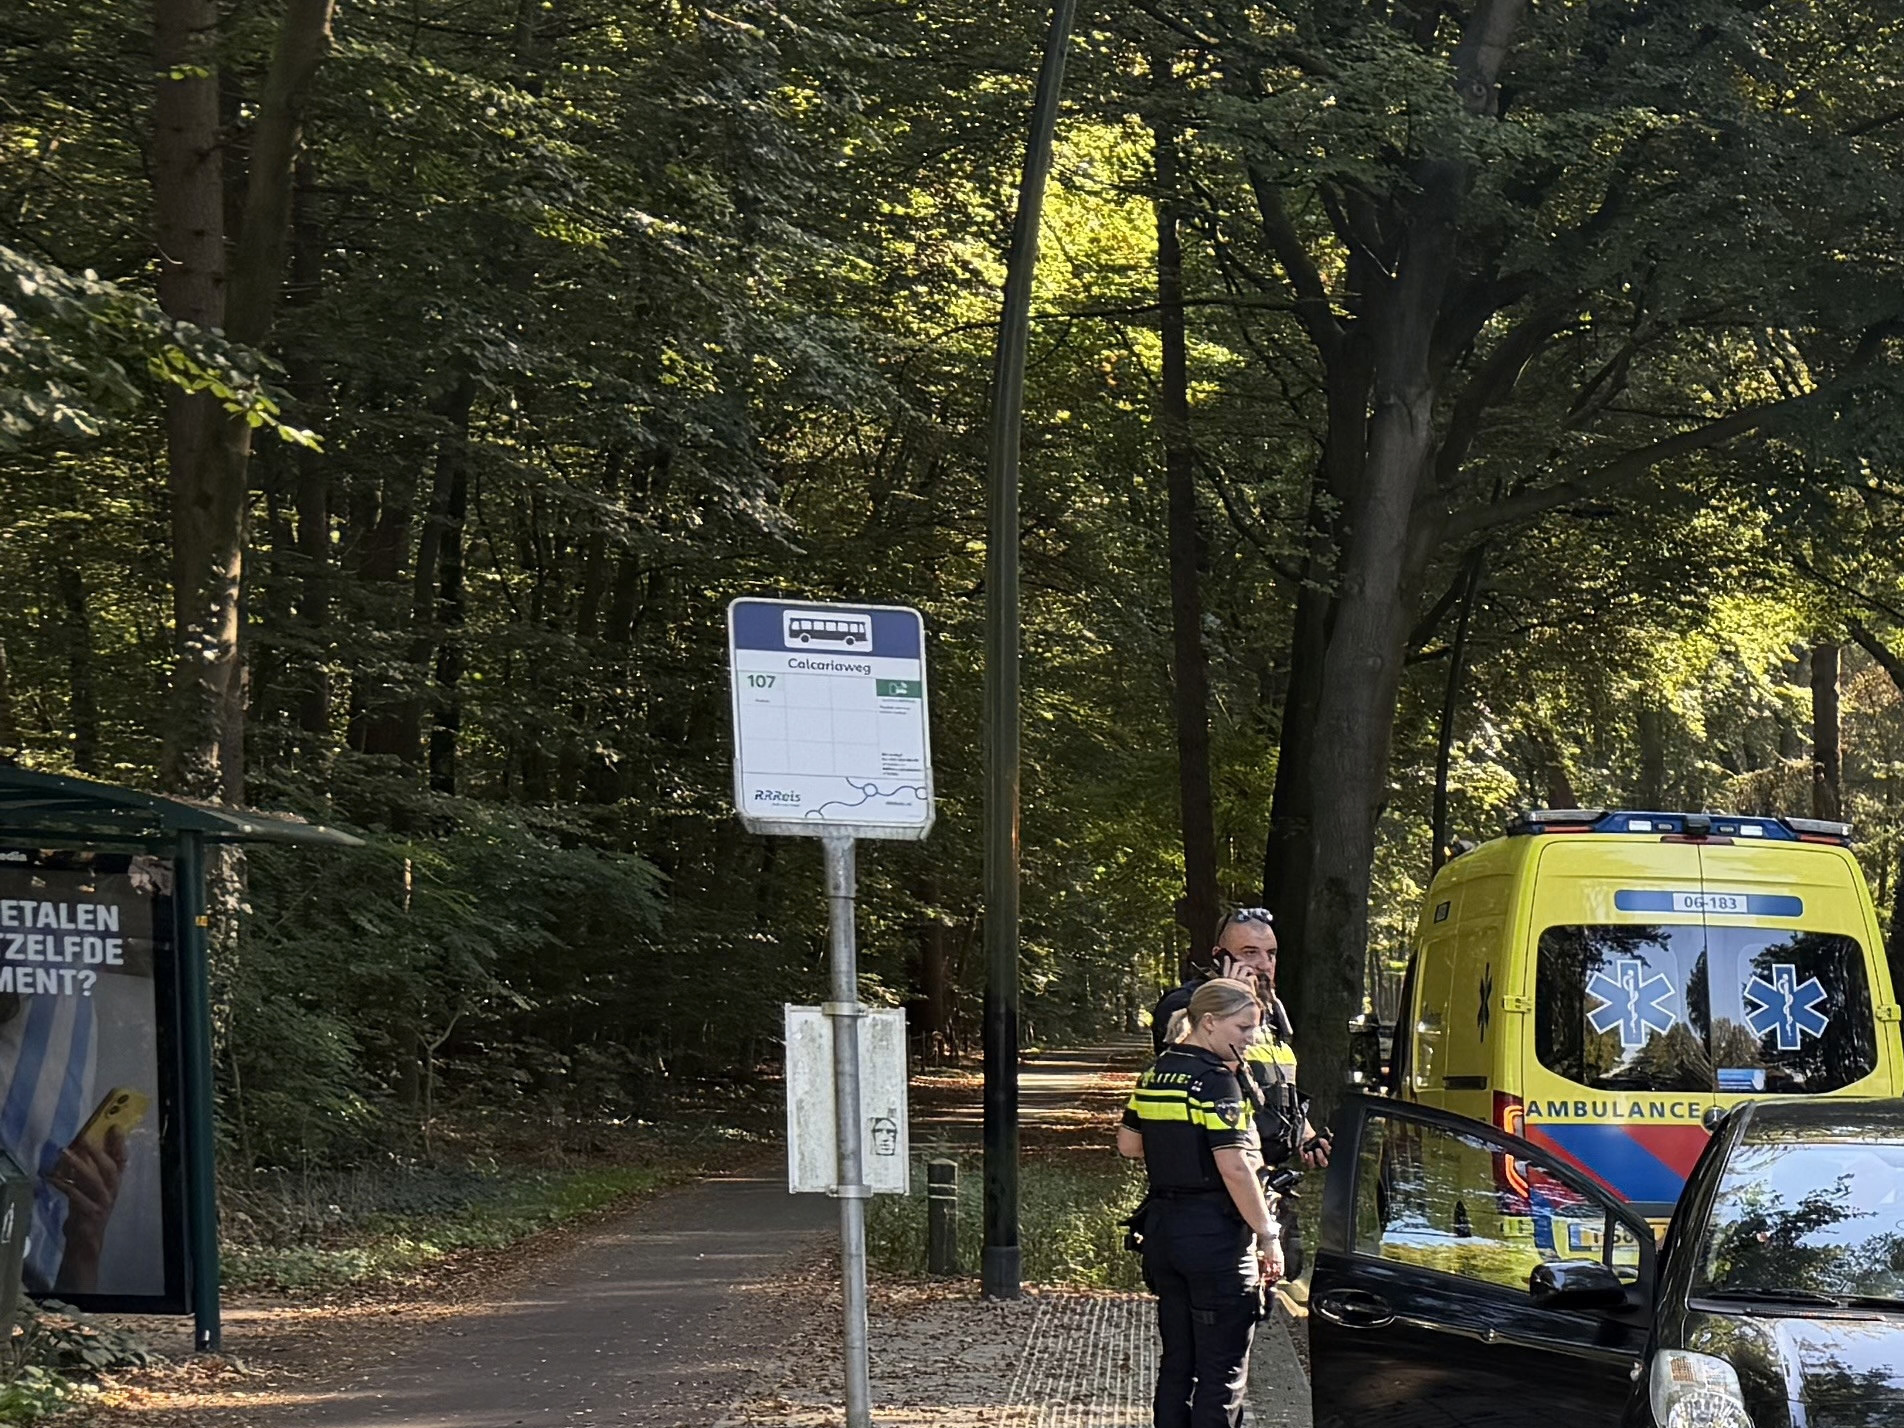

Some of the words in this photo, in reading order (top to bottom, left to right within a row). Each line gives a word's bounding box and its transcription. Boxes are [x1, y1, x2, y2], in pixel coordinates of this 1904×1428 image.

[788, 657, 871, 675] Calcariaweg
[747, 674, 776, 688] 107
[1684, 896, 1737, 909] 06-183
[0, 933, 124, 965] ZELFDE
[1526, 1100, 1700, 1119] AMBULANCE
